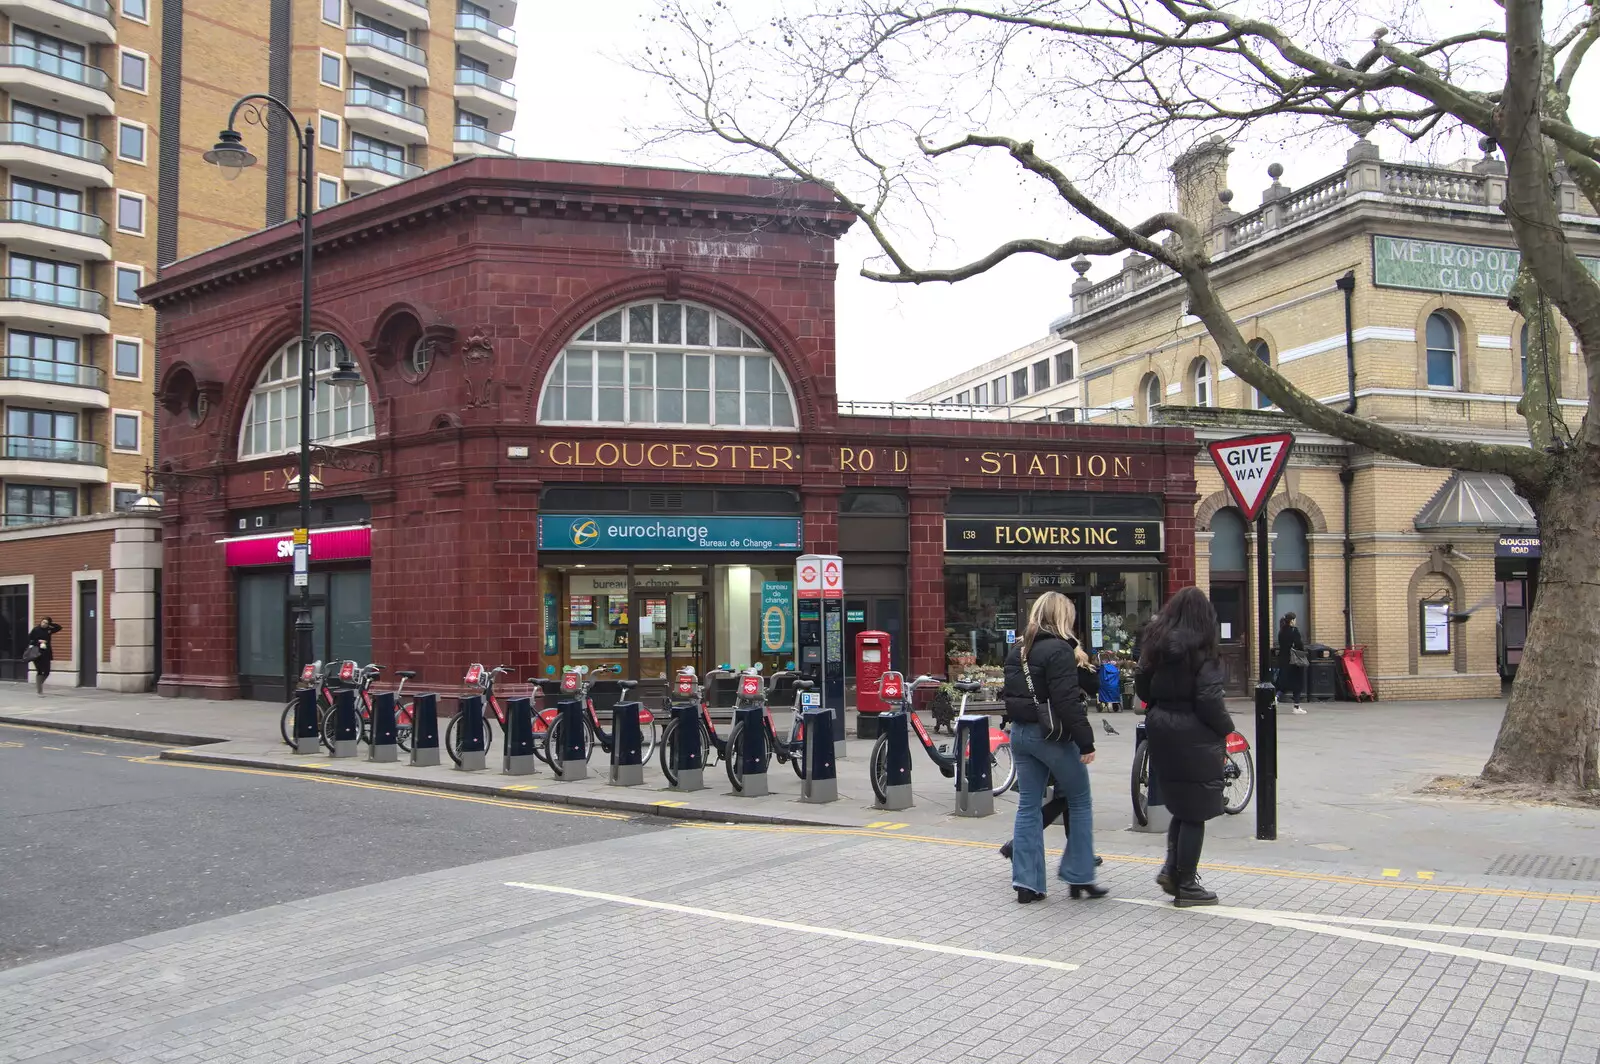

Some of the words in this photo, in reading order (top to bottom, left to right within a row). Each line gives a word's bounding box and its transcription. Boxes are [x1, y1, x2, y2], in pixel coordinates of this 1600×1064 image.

[1440, 267, 1514, 293] GLOUC
[549, 441, 794, 470] GLOUCESTER
[980, 451, 1132, 478] STATION
[1227, 446, 1272, 466] GIVE
[264, 463, 325, 491] EXT
[1235, 467, 1263, 481] WAY
[607, 521, 708, 542] eurochange
[963, 530, 976, 539] 138
[995, 526, 1081, 545] FLOWERS
[1085, 527, 1118, 545] INC
[700, 538, 727, 547] Bureau
[730, 539, 740, 547] de
[743, 538, 773, 549] Change
[1499, 538, 1541, 546] GLOUCESTER
[1511, 546, 1529, 554] ROAD
[1030, 576, 1049, 585] OPEN
[1051, 576, 1056, 585] 7
[1057, 576, 1076, 585] DAYS
